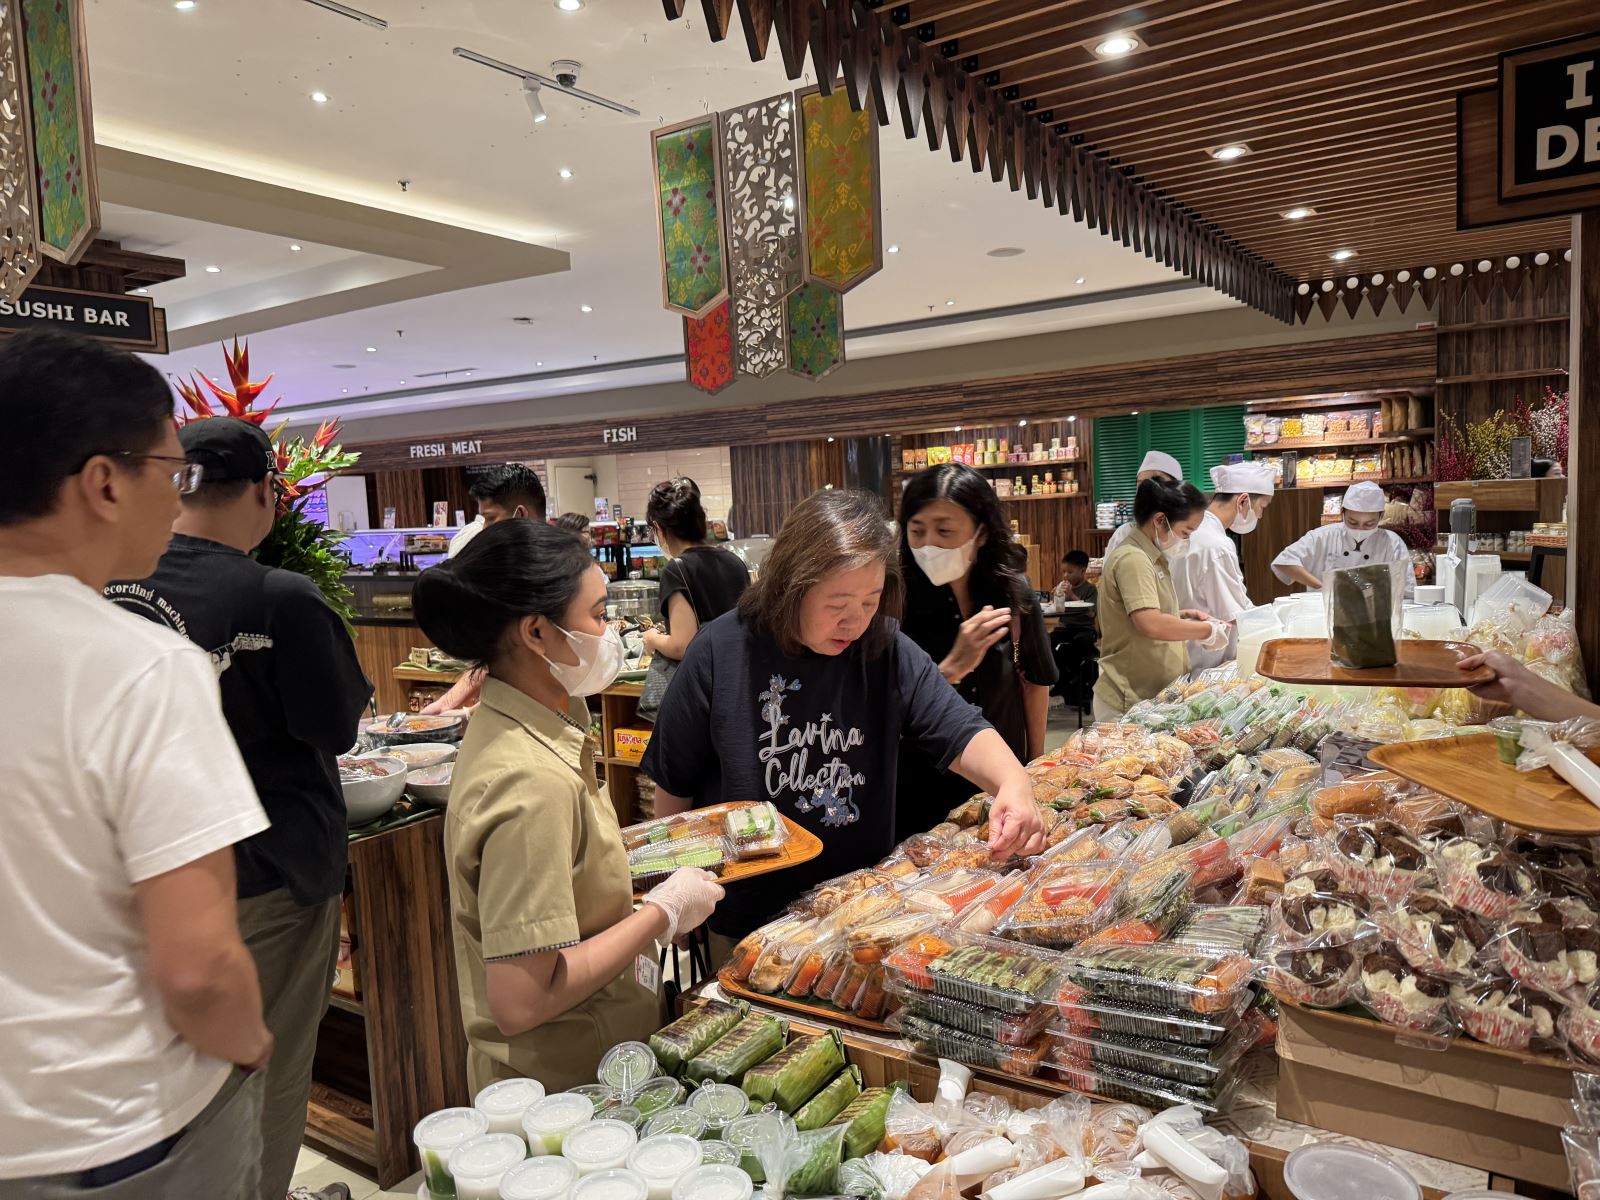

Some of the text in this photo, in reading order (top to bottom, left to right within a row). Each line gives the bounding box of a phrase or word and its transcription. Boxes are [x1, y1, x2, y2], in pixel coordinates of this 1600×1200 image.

[0, 299, 130, 327] SUSHI BAR
[603, 426, 637, 444] FISH
[410, 440, 483, 459] FRESH MEAT
[102, 583, 155, 602] ecording
